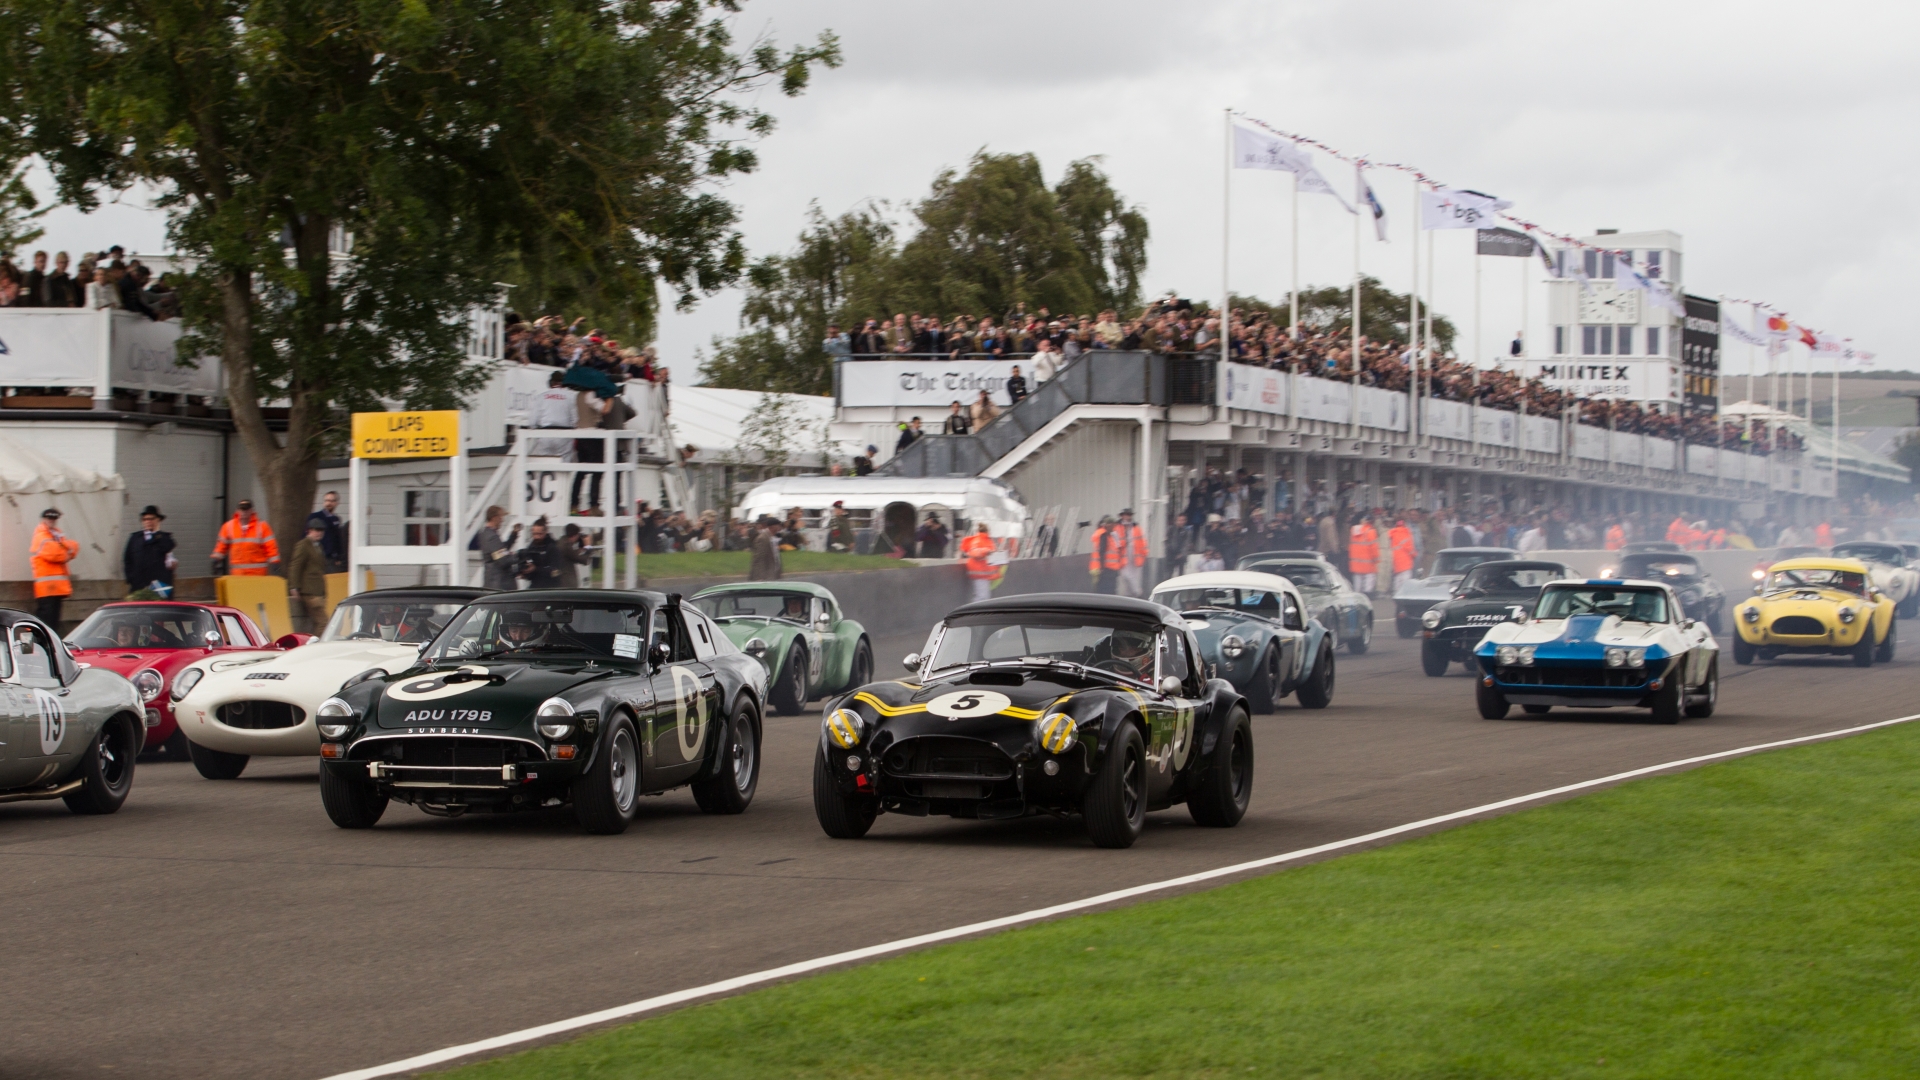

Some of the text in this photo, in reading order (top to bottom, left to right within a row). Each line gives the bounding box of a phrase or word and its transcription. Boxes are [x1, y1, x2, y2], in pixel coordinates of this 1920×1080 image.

[1541, 364, 1630, 380] MINTEX
[898, 372, 939, 394] The
[387, 416, 424, 431] LAPS
[362, 437, 449, 453] COMPLETED
[949, 694, 985, 711] 5
[40, 696, 62, 741] 19
[404, 709, 492, 721] ADU 179B
[681, 674, 700, 749] 8
